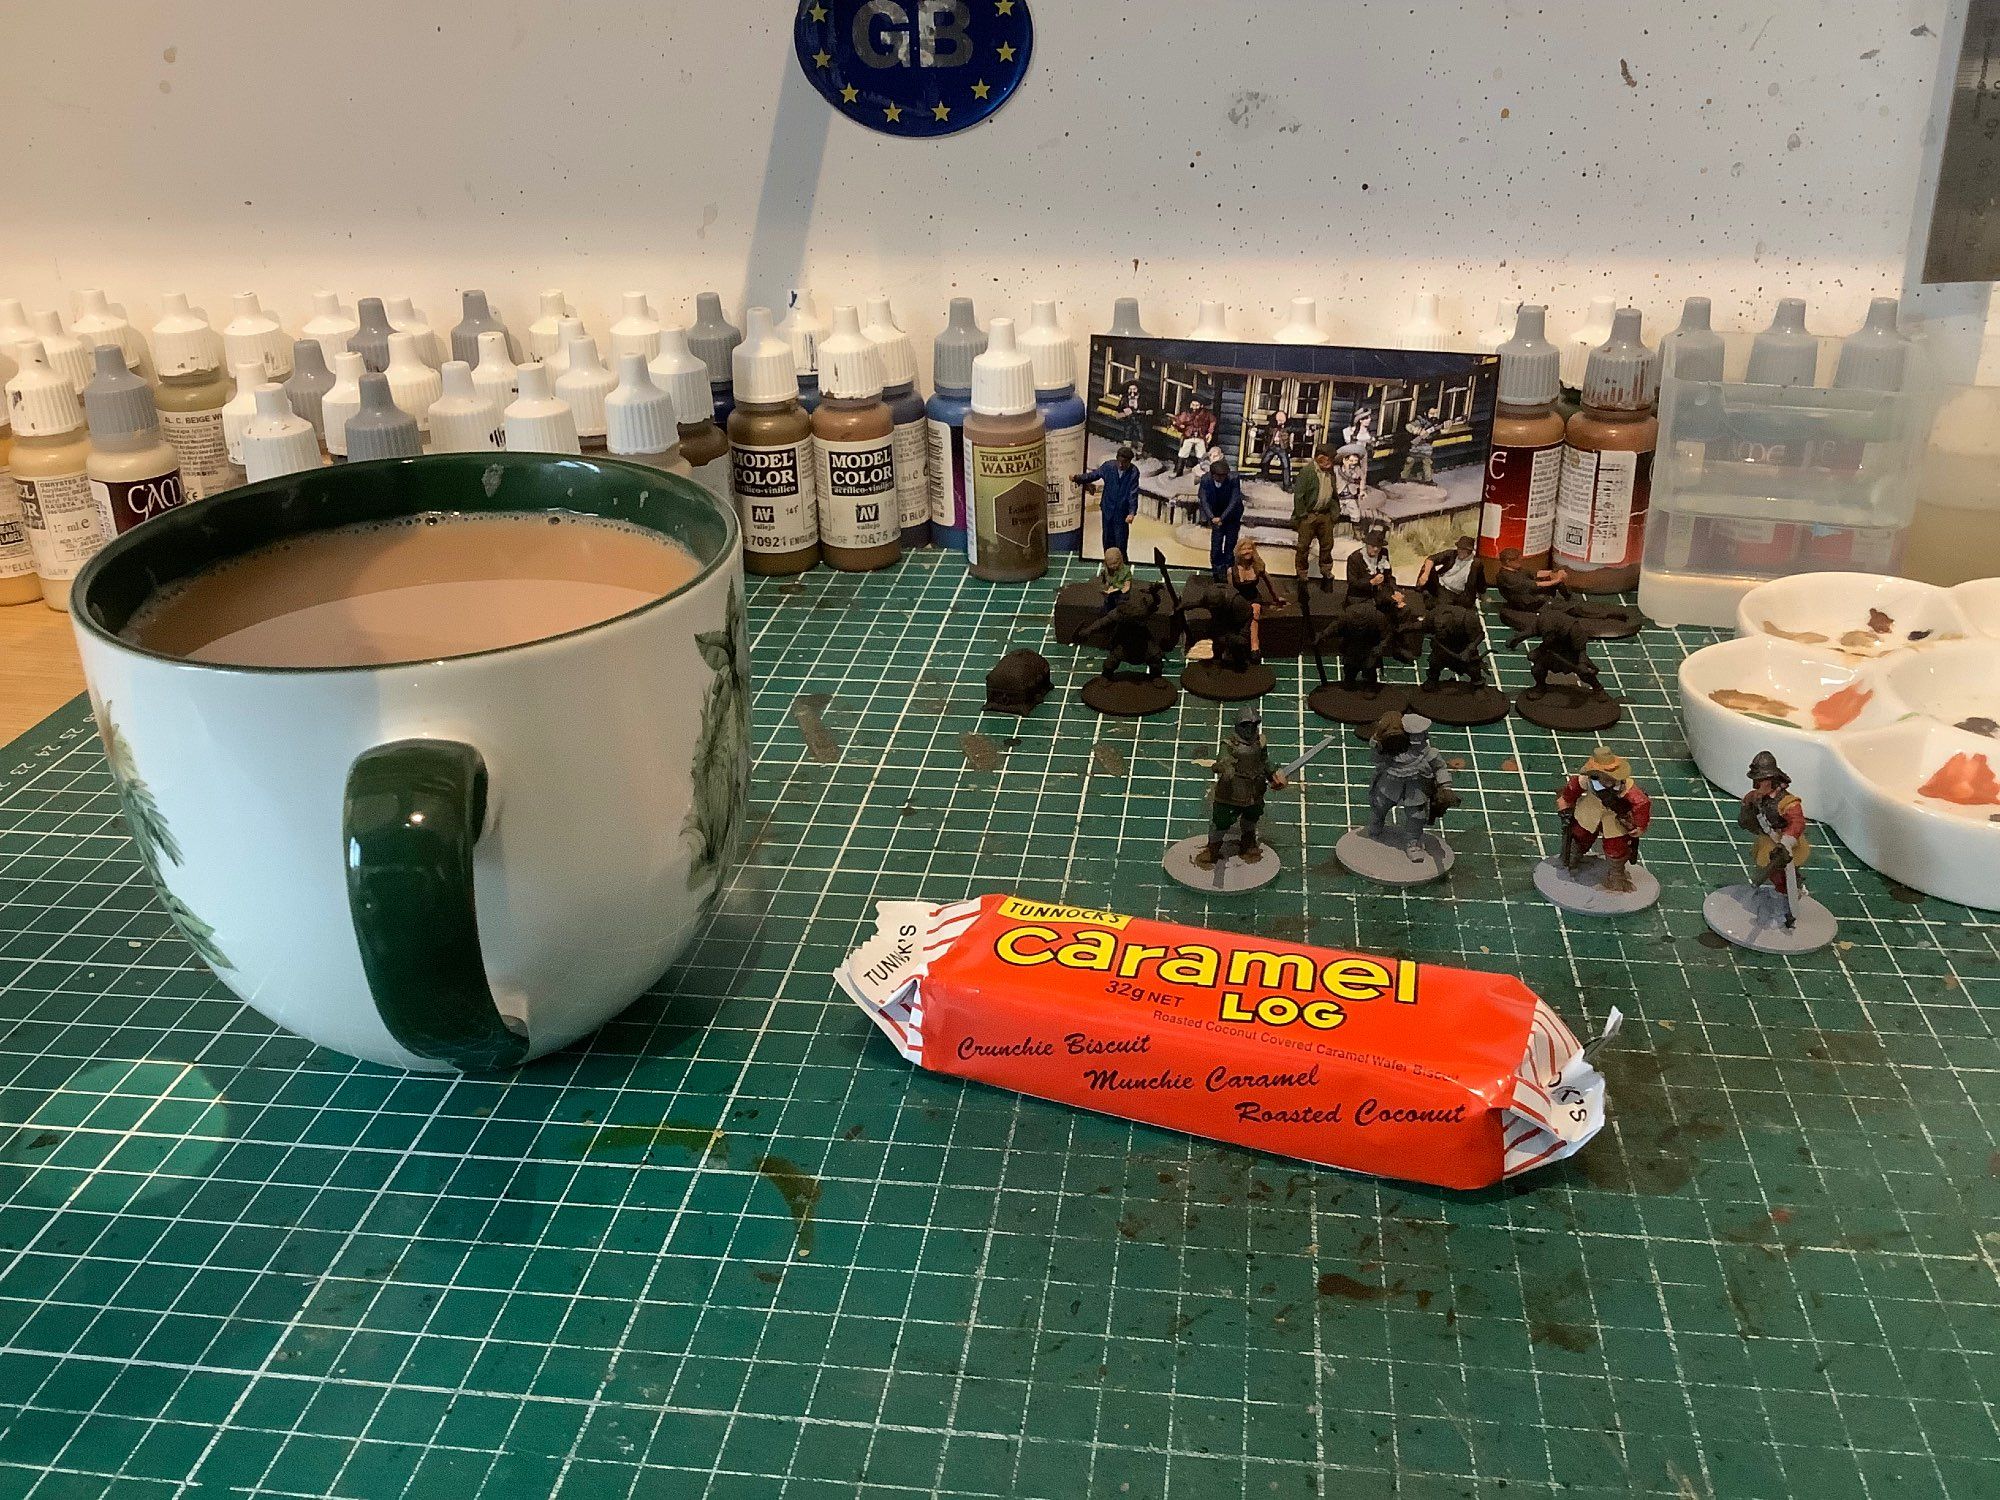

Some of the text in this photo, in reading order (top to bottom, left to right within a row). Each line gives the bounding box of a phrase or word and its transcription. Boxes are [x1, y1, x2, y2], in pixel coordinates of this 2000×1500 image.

[851, 0, 974, 69] GB
[830, 449, 892, 469] MODEL
[980, 453, 1000, 463] THE
[1001, 453, 1027, 463] ARMY
[980, 458, 1043, 474] WARPAIN
[735, 468, 796, 486] COLOR
[832, 465, 893, 486] COLOR
[753, 523, 776, 532] vallejo
[1048, 517, 1074, 530] BLUE
[750, 534, 788, 548] 70921
[1009, 902, 1121, 924] TUNNOCK'S
[1104, 979, 1185, 1009] 32g NET
[1218, 990, 1348, 1031] LOG
[957, 1033, 1152, 1061] Crunchie Biscuit
[1152, 1009, 1203, 1029] Roasted
[1205, 1020, 1258, 1041] Coconut
[1260, 1032, 1313, 1053] Covered
[1315, 1043, 1370, 1064] Caramel
[1372, 1054, 1409, 1073] Wafer
[1083, 1062, 1320, 1093] Munchie Caramel
[1234, 1098, 1467, 1127] Roasted Coconut
